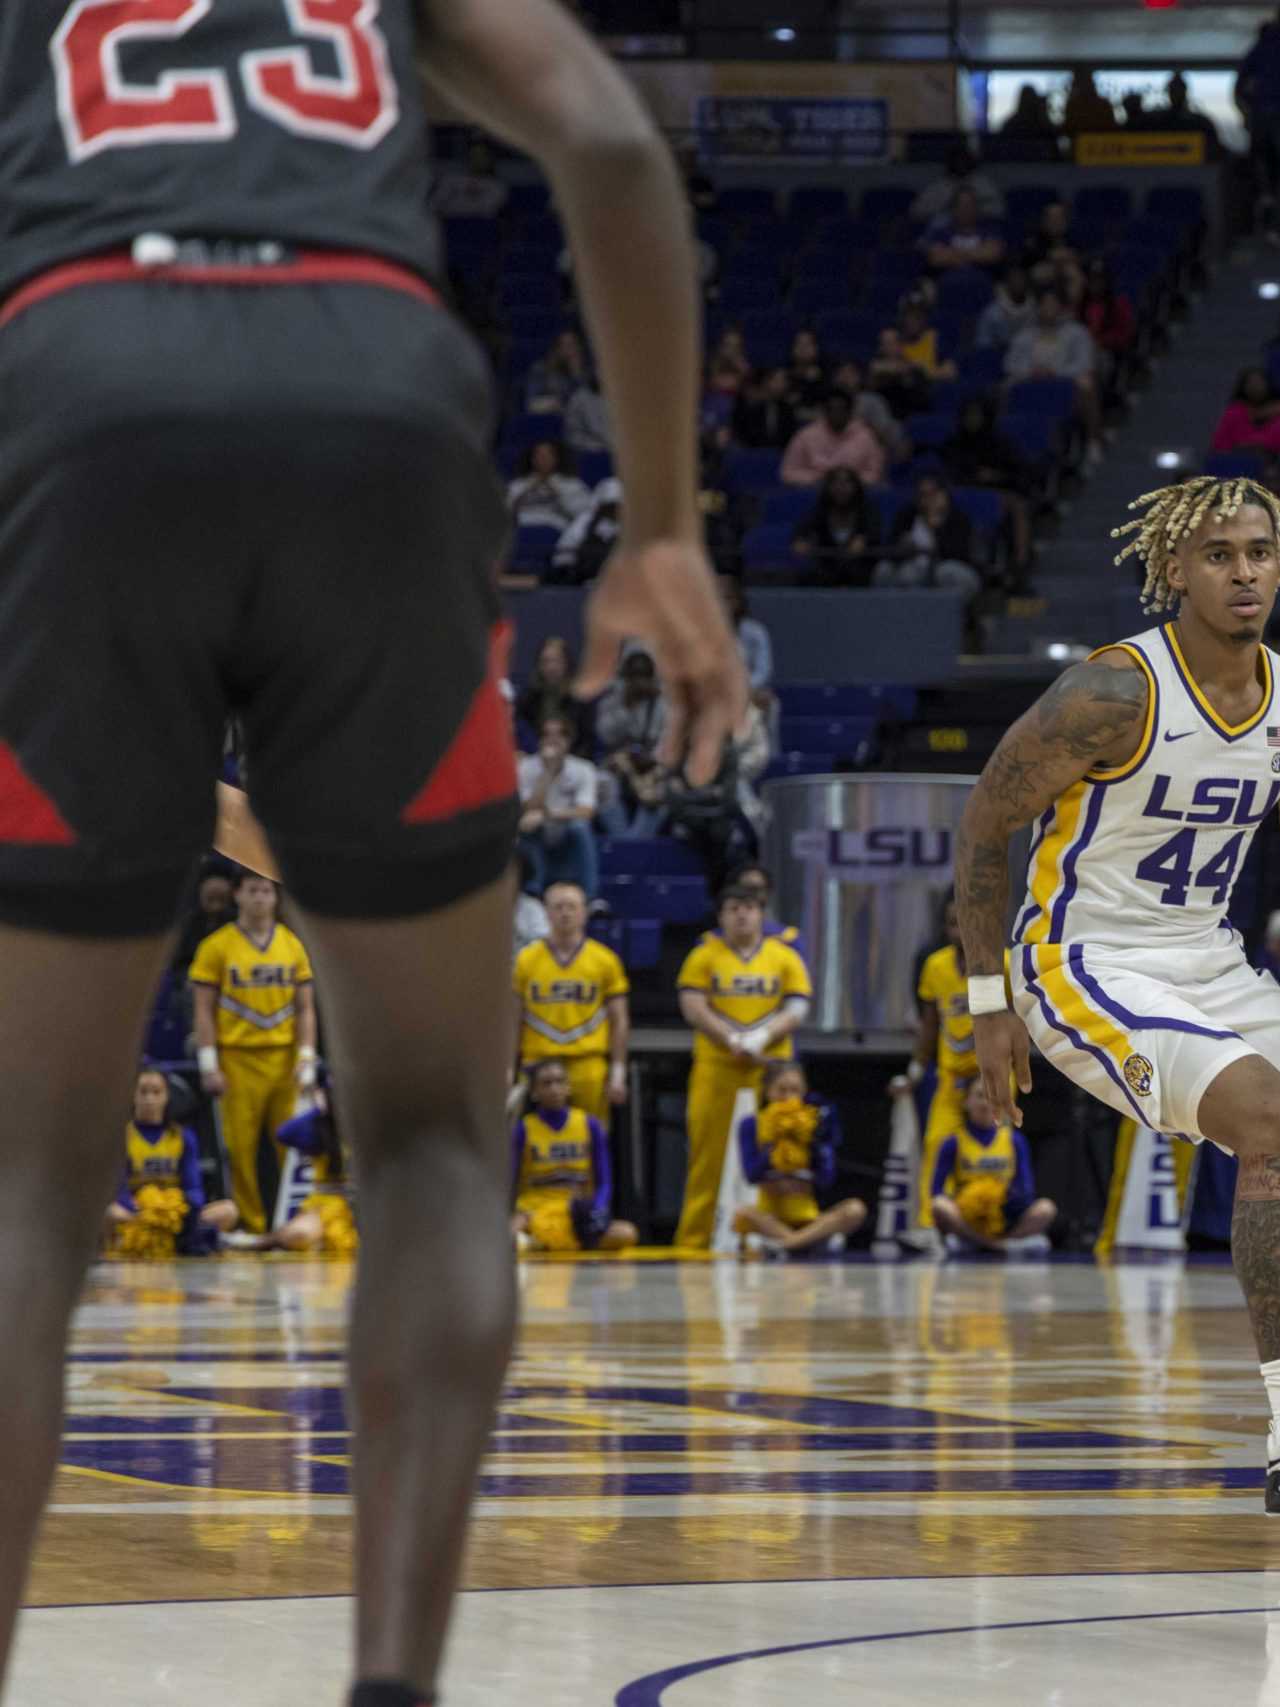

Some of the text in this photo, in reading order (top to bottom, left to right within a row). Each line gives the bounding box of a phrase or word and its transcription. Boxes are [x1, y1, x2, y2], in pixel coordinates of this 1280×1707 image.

[51, 0, 398, 165] 23
[828, 826, 952, 868] LSU
[1136, 827, 1246, 906] 44
[531, 981, 599, 1003] LSU
[711, 976, 780, 997] LSU
